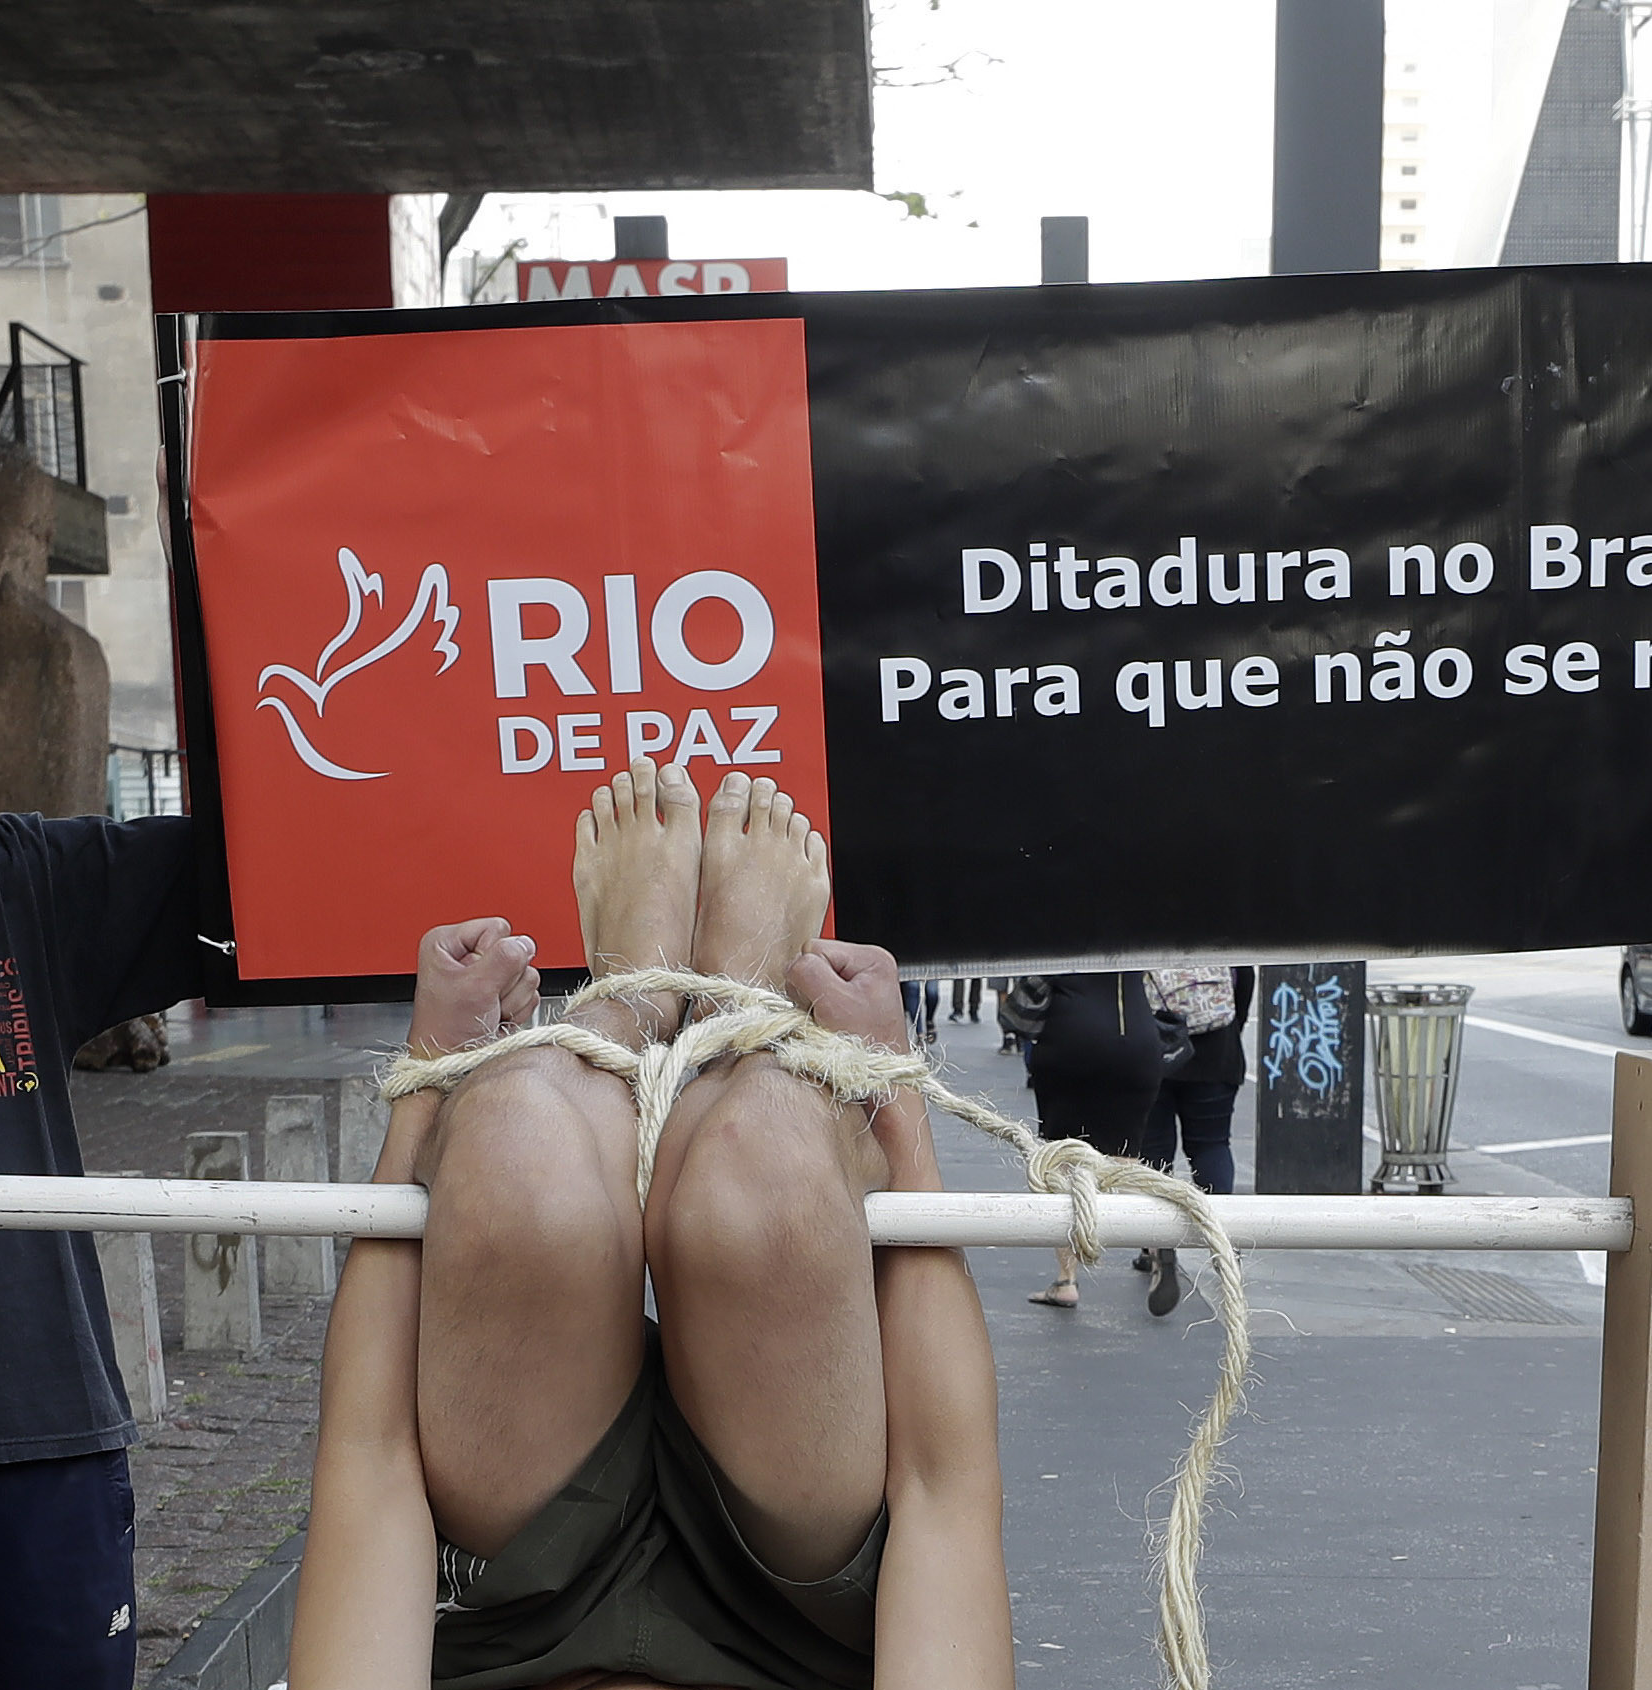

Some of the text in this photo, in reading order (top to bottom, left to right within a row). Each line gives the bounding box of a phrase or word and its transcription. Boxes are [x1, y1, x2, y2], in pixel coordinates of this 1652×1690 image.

[960, 536, 1352, 614] Ditadura
[1388, 541, 1495, 597] no
[487, 569, 775, 699] RIO
[879, 656, 1081, 723] Para
[1115, 653, 1281, 728] que
[1314, 630, 1474, 703] não
[1505, 640, 1601, 696] se
[497, 706, 783, 774] DE PAZ
